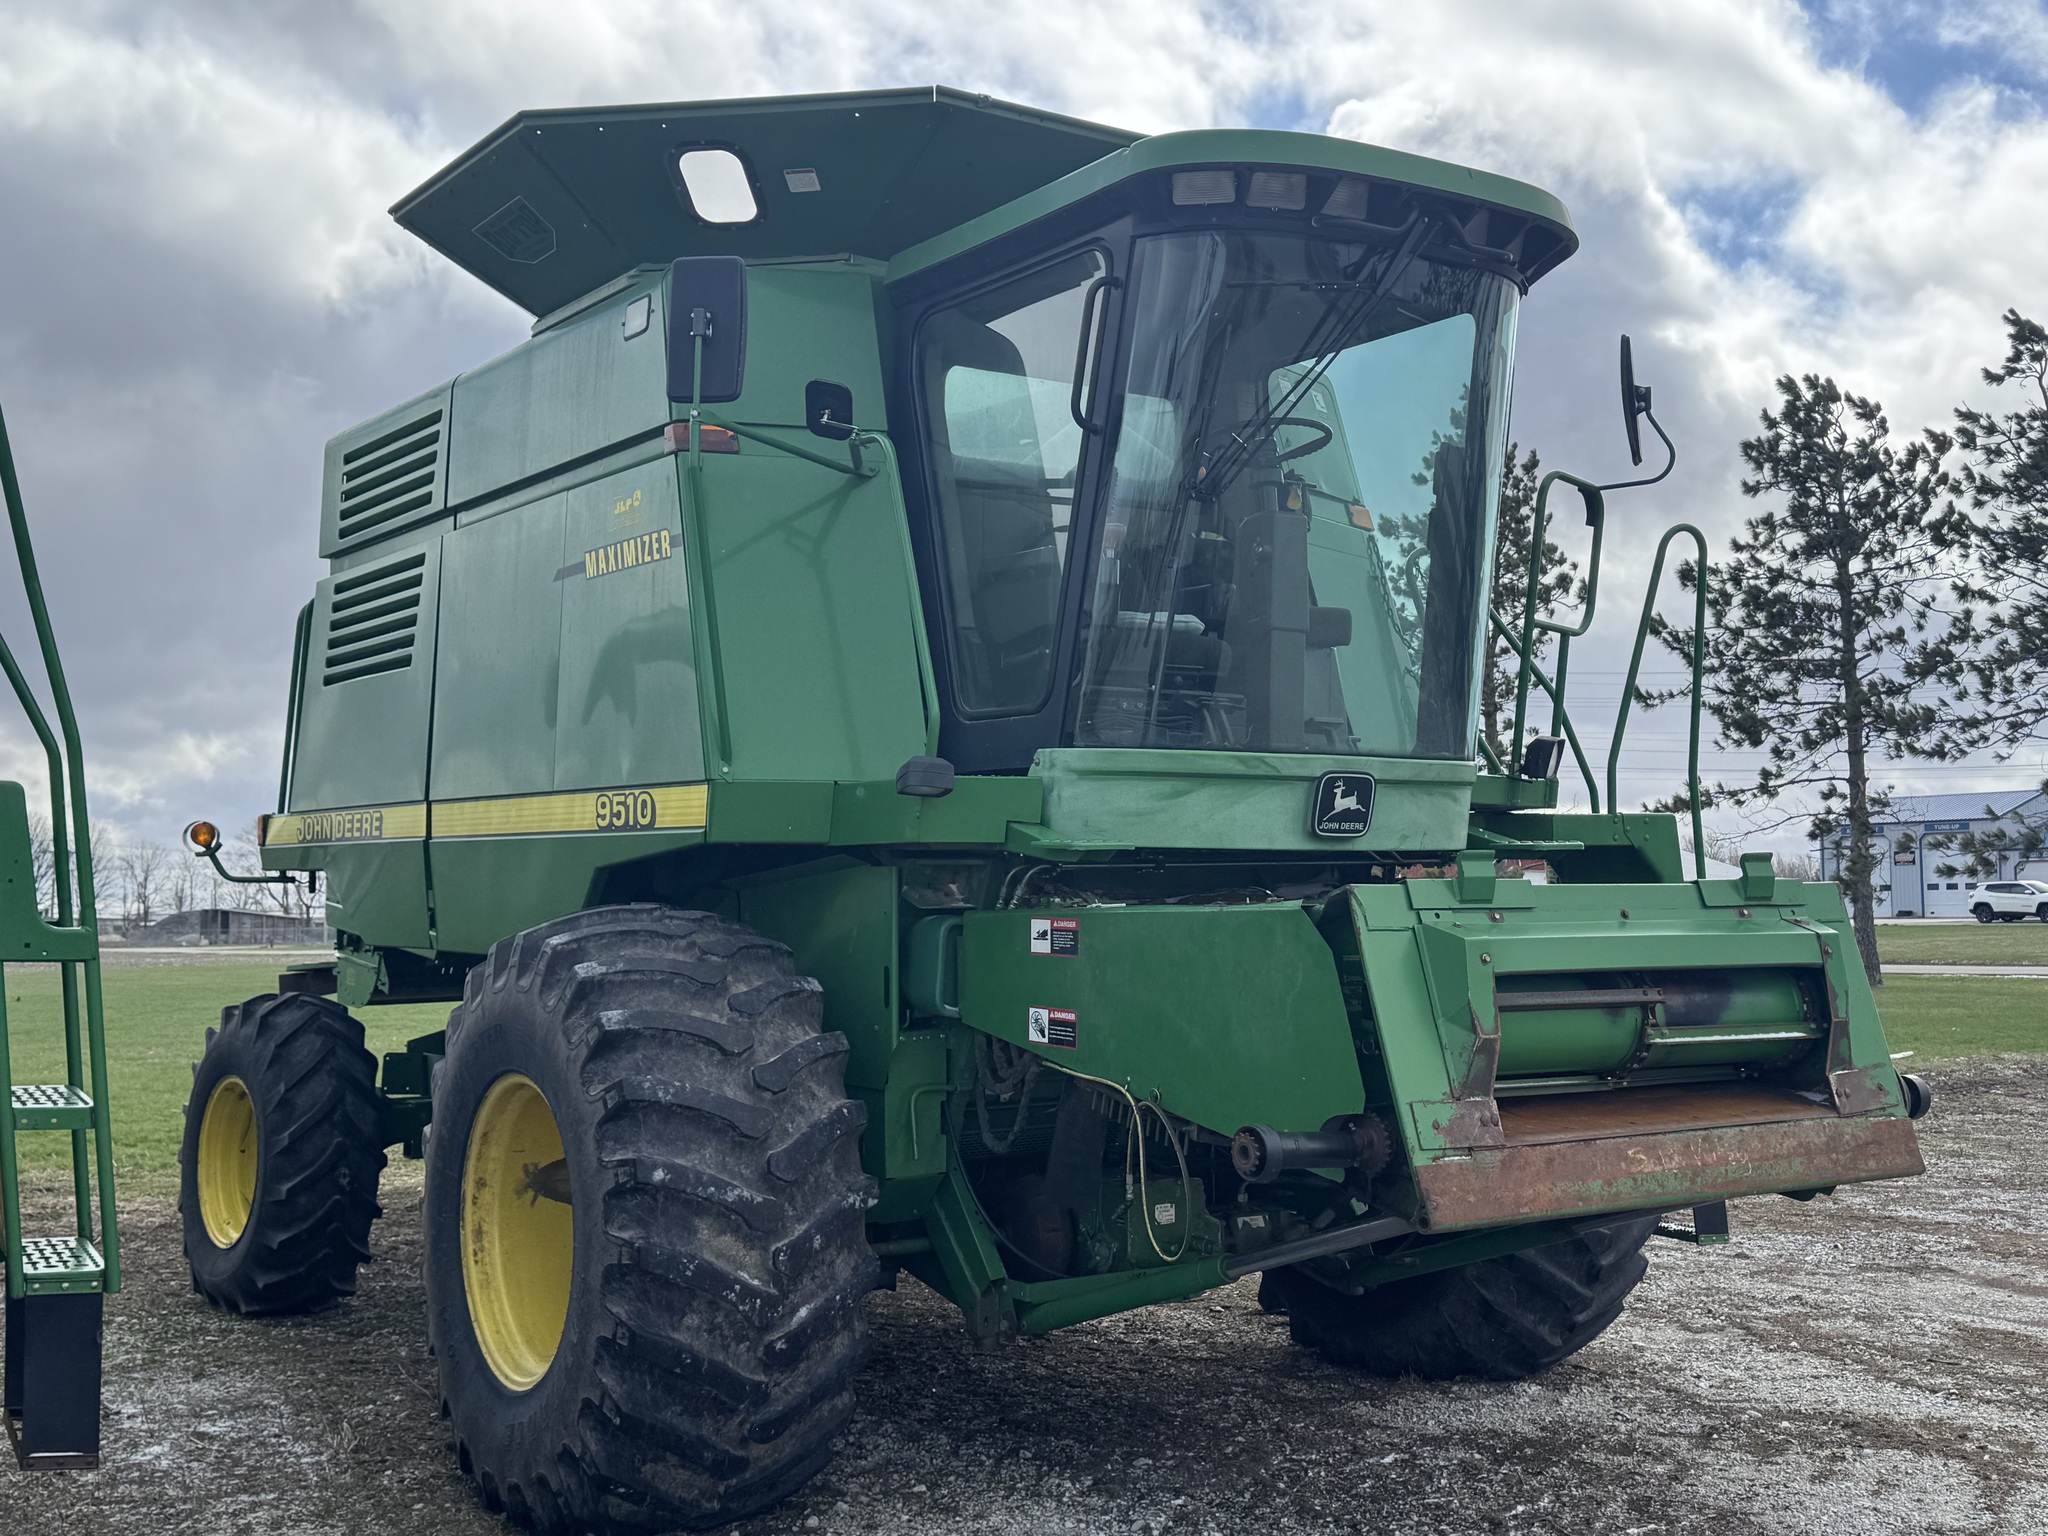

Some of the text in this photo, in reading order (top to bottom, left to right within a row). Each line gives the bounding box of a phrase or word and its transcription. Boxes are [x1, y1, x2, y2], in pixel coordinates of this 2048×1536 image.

[584, 529, 671, 579] MAXIMIZER
[596, 791, 654, 828] 9510
[297, 811, 382, 841] JOHN DEERE
[1319, 821, 1364, 830] JOHN DEERE
[1057, 920, 1076, 928] DANGER
[1054, 1011, 1076, 1020] DANGER
